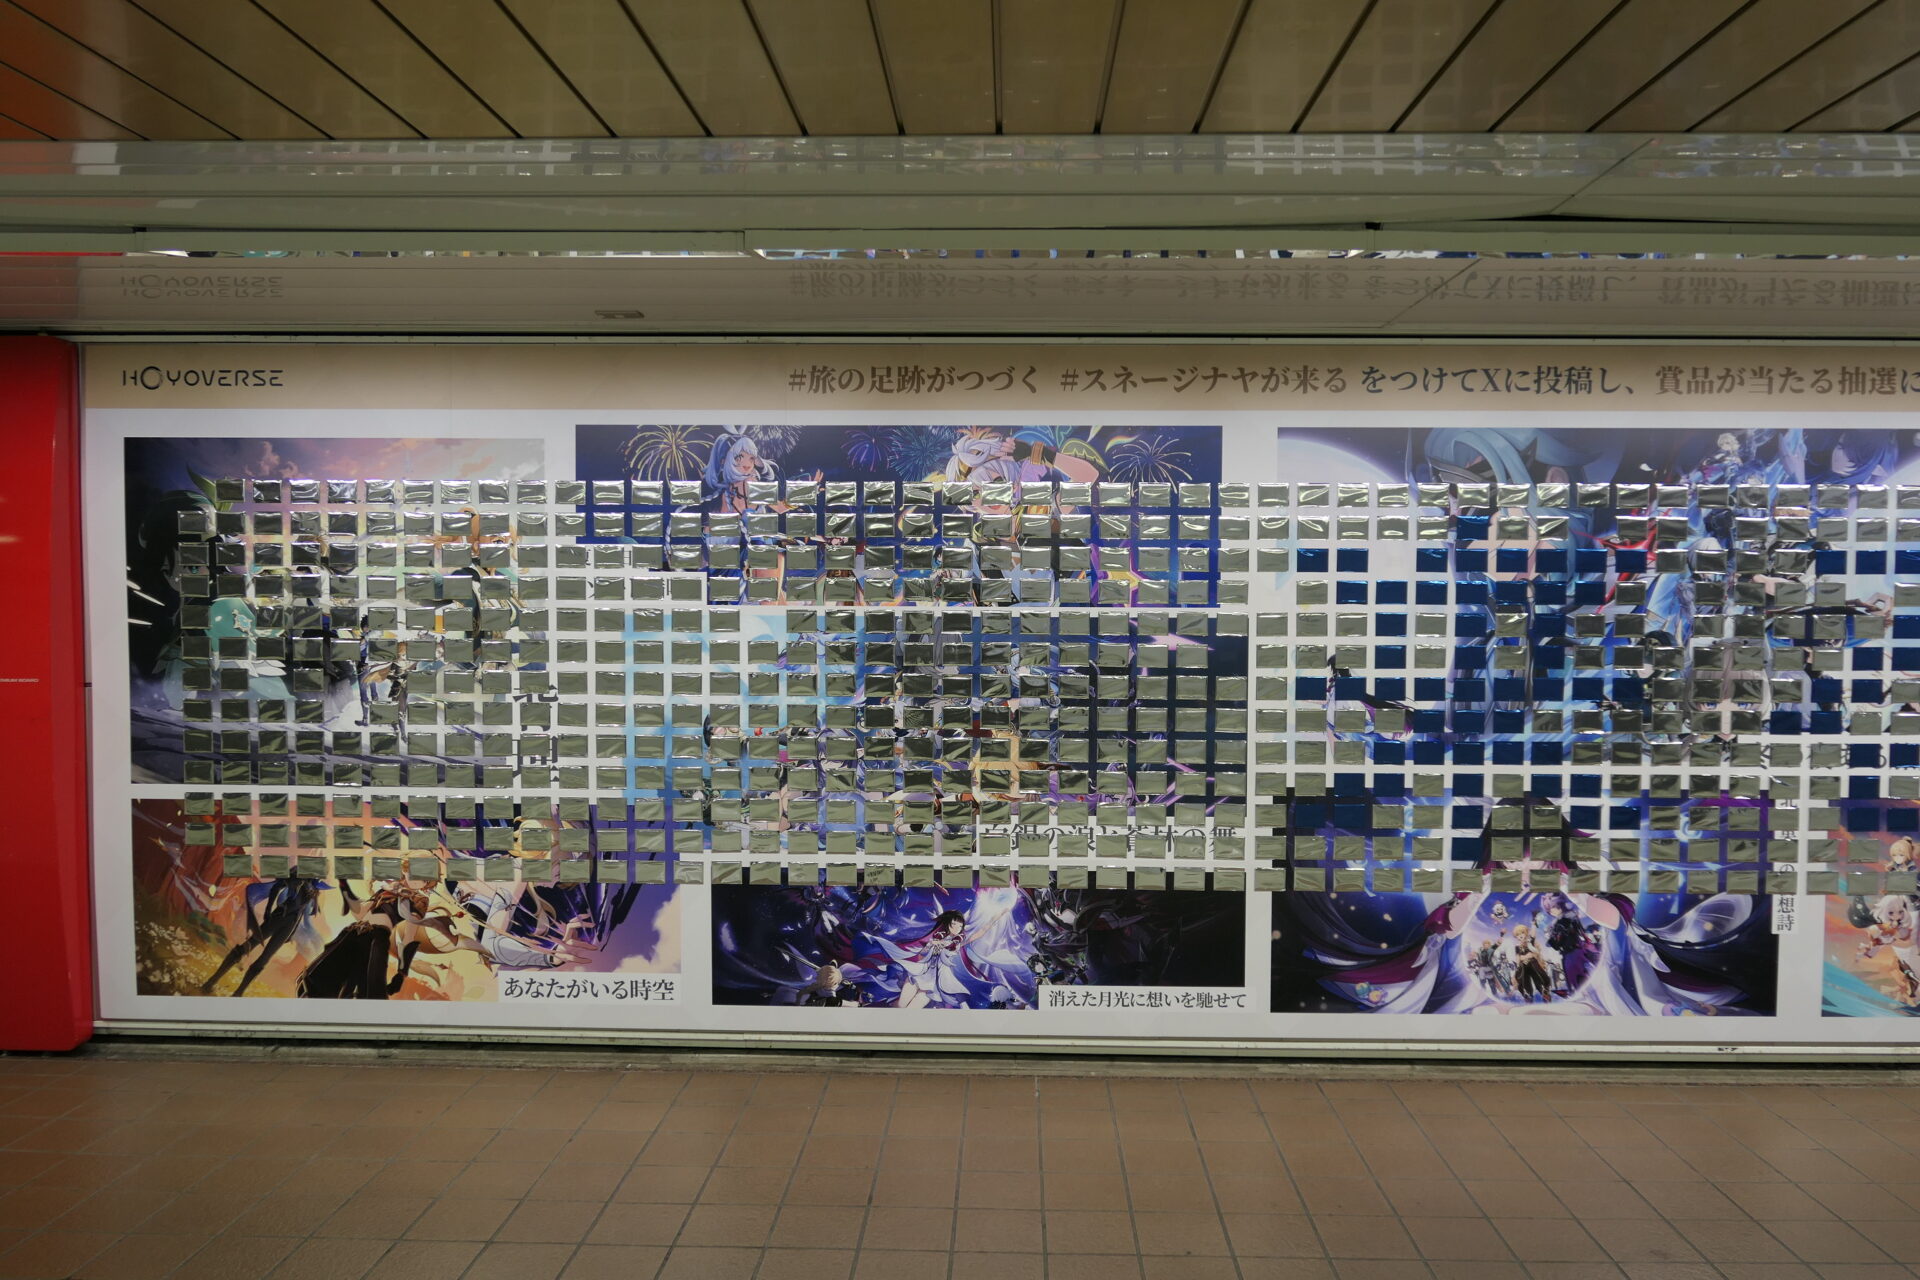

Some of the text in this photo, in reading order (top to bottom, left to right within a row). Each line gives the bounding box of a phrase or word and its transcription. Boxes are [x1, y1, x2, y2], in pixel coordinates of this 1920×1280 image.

[122, 366, 284, 390] HOYOVERSE
[788, 365, 1038, 394] #旅の足跡がつづく
[1060, 366, 1348, 394] #スネージナヤが来る
[504, 977, 675, 1001] あなたがいる時空
[1049, 990, 1247, 1009] 消えた月光に想いを馳せて
